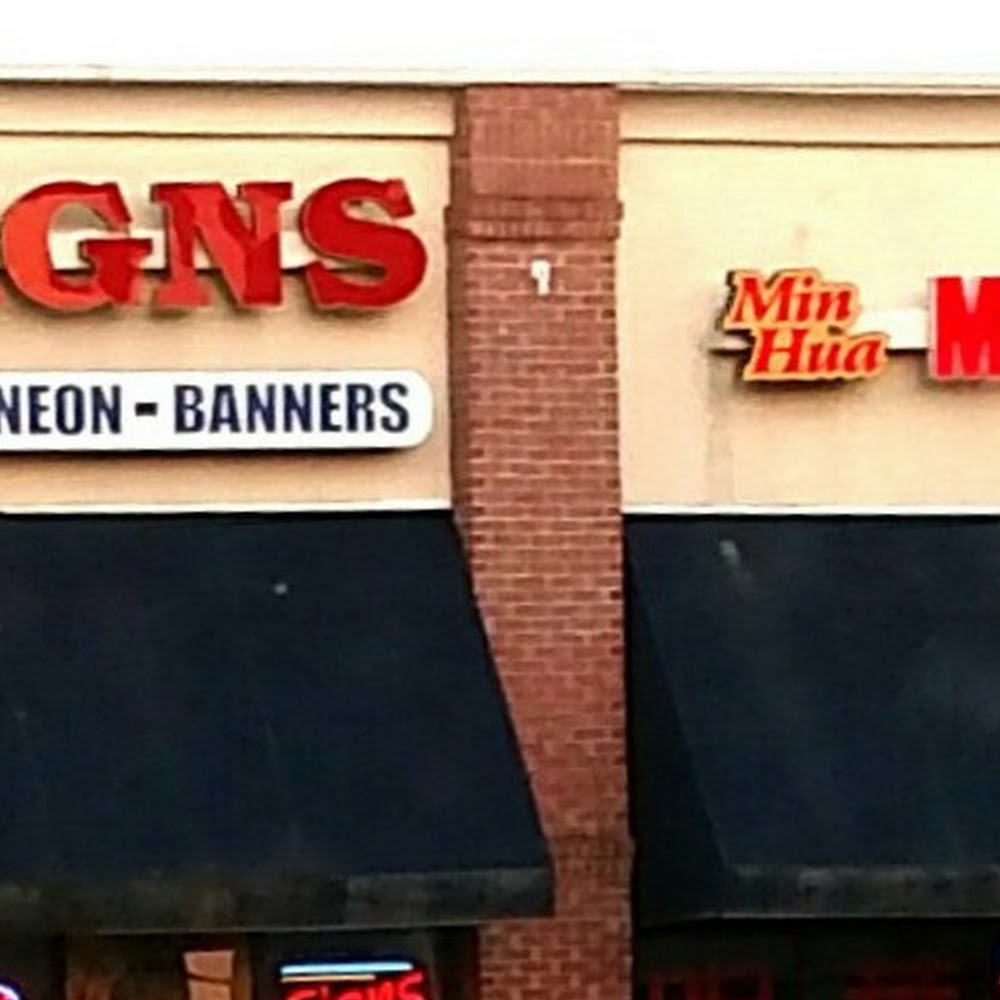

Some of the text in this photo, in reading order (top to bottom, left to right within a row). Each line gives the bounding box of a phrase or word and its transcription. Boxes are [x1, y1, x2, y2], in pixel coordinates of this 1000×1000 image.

[731, 275, 854, 322] Min
[753, 327, 884, 374] Hua
[173, 382, 410, 434] BANNERS
